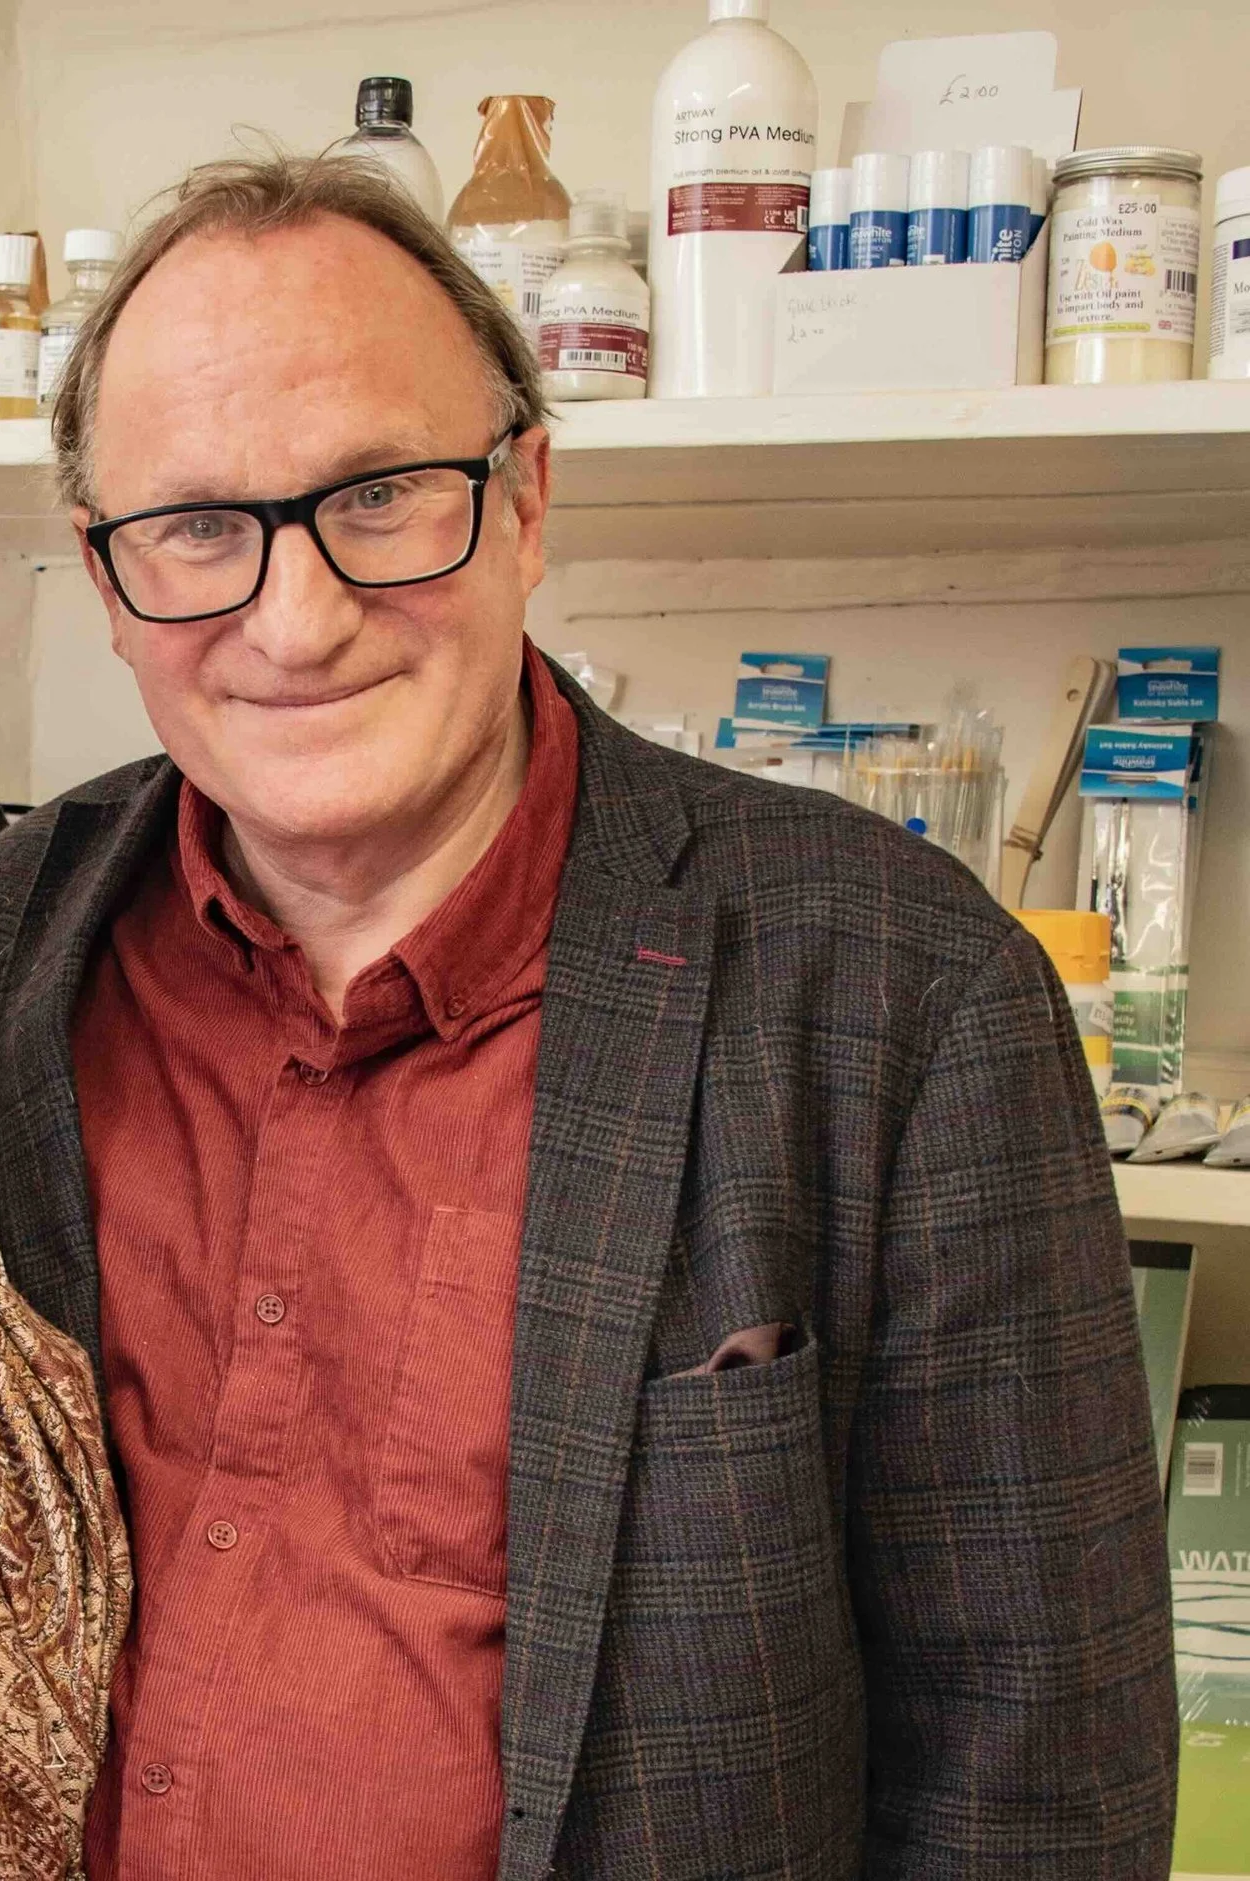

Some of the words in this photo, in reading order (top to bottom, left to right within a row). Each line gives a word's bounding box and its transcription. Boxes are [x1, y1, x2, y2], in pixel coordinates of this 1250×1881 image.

[674, 107, 716, 122] ARTWAY
[674, 128, 723, 145] Strong
[729, 126, 761, 141] PVA
[716, 167, 749, 176] premium
[1076, 216, 1098, 228] Cold
[1102, 216, 1124, 226] Wax
[1062, 230, 1097, 243] Painting
[1100, 228, 1143, 239] Medium
[1115, 288, 1142, 300] paint
[564, 306, 588, 316] PVA
[591, 306, 640, 320] Medium
[1064, 302, 1094, 315] impart
[1096, 300, 1121, 312] body
[1124, 299, 1145, 310] and
[1178, 1550, 1250, 1572] WAT
